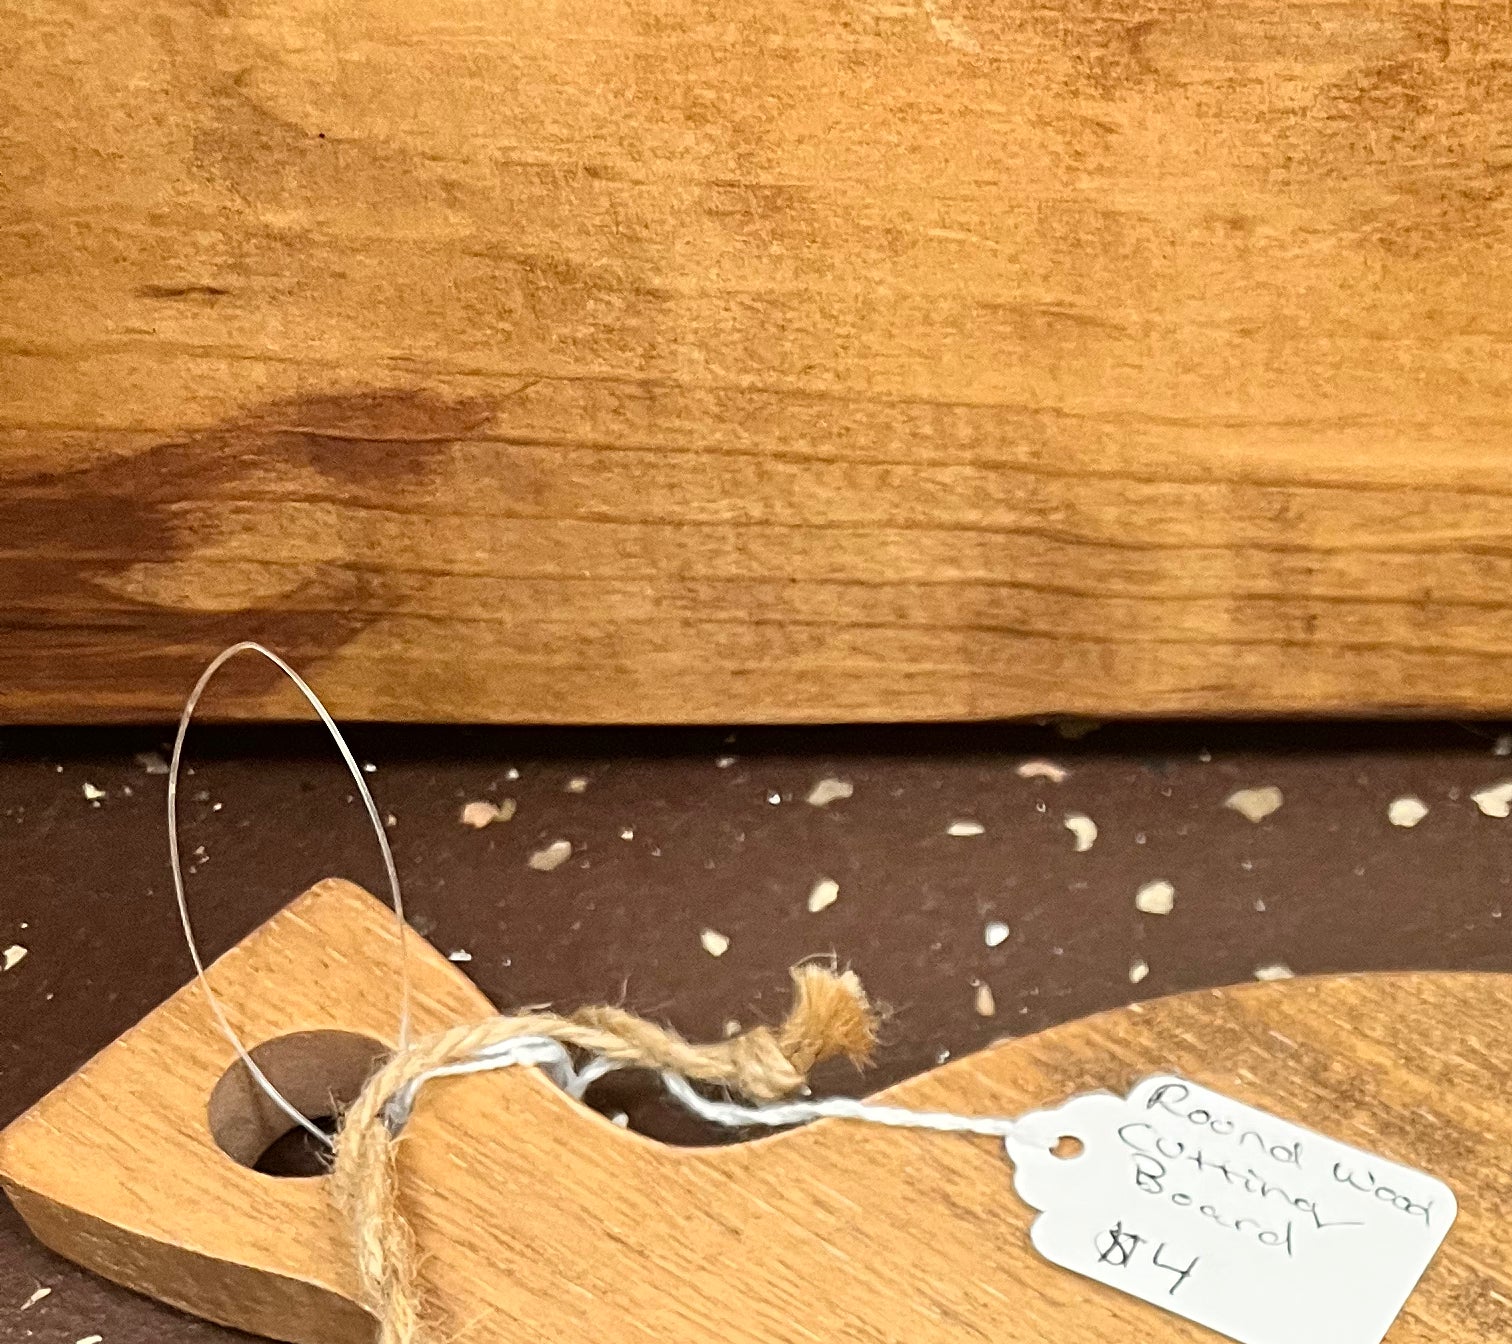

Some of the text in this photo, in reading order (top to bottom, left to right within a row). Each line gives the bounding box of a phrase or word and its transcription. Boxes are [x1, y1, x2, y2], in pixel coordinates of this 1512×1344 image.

[1147, 1084, 1303, 1167] Round
[1118, 1122, 1365, 1229] Cutting
[1132, 1154, 1293, 1257] Board
[1094, 1221, 1201, 1296] $4
